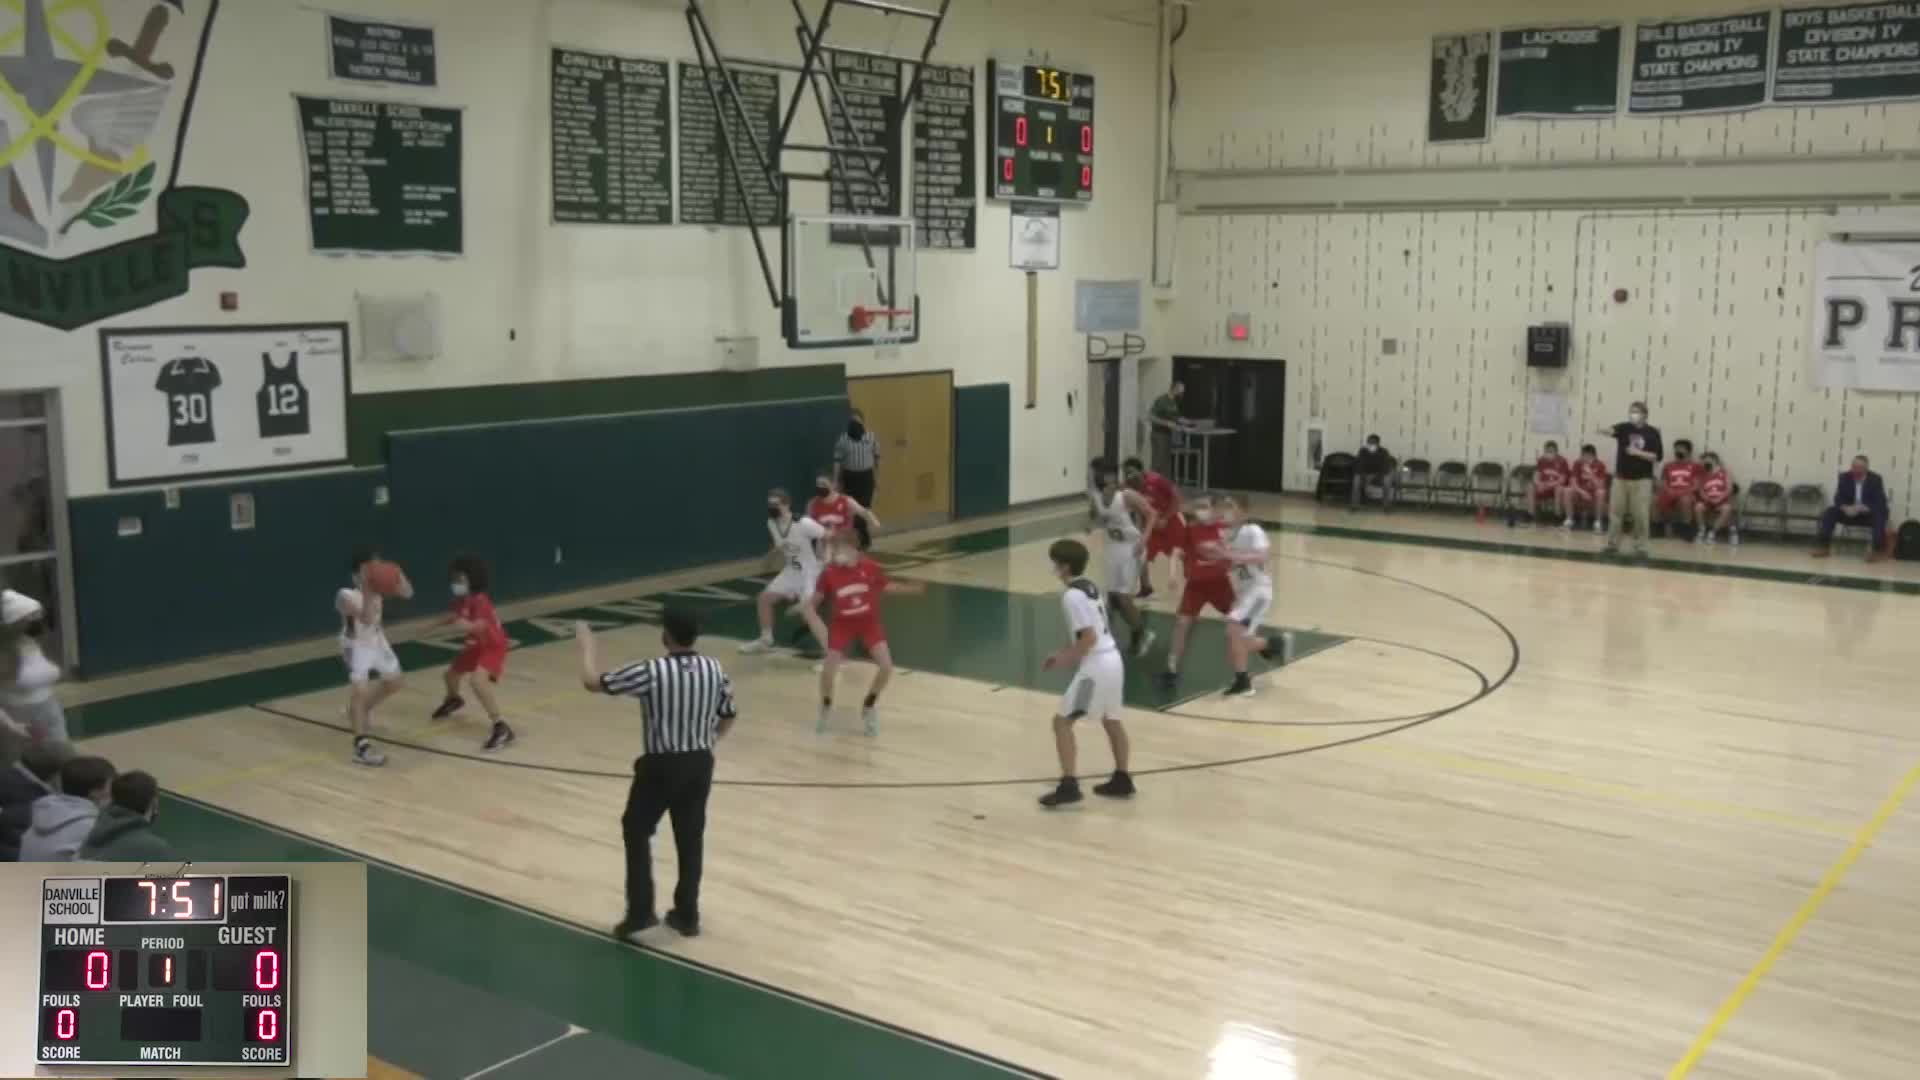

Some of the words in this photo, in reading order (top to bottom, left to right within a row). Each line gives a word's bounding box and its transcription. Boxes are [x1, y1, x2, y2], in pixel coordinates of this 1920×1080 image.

[1882, 24, 1903, 39] IV
[1656, 41, 1720, 58] DIVISION
[1724, 38, 1743, 52] IV
[1786, 47, 1830, 64] STATE
[1836, 42, 1919, 61] CHAMPIONS
[1640, 61, 1680, 77] STATE
[1684, 55, 1758, 75] CHAMPIONS
[1015, 116, 1027, 146] 0
[1081, 125, 1091, 153] 0
[1004, 158, 1014, 182] 0
[1081, 165, 1090, 188] 0
[172, 393, 208, 426] 30
[267, 383, 300, 416] 12
[46, 888, 99, 901] DANVILLE
[138, 881, 220, 917] 7:51
[231, 891, 249, 912] got
[253, 890, 285, 910] milk?
[49, 902, 94, 915] SCHOOL
[55, 928, 104, 945] HOME
[141, 937, 185, 949] PERIOD
[218, 926, 277, 944] GUEST
[87, 952, 109, 989] 0
[164, 957, 171, 983] 1
[255, 951, 278, 989] 0
[43, 994, 80, 1007] FOULS
[120, 995, 164, 1007] PLAYER
[173, 995, 203, 1007] FOUL
[243, 995, 281, 1008] FOULS
[57, 1009, 75, 1039] 0
[258, 1010, 277, 1040] 0
[42, 1046, 80, 1059] SCORE
[140, 1047, 181, 1060] MATCH
[242, 1047, 282, 1061] SCORE
